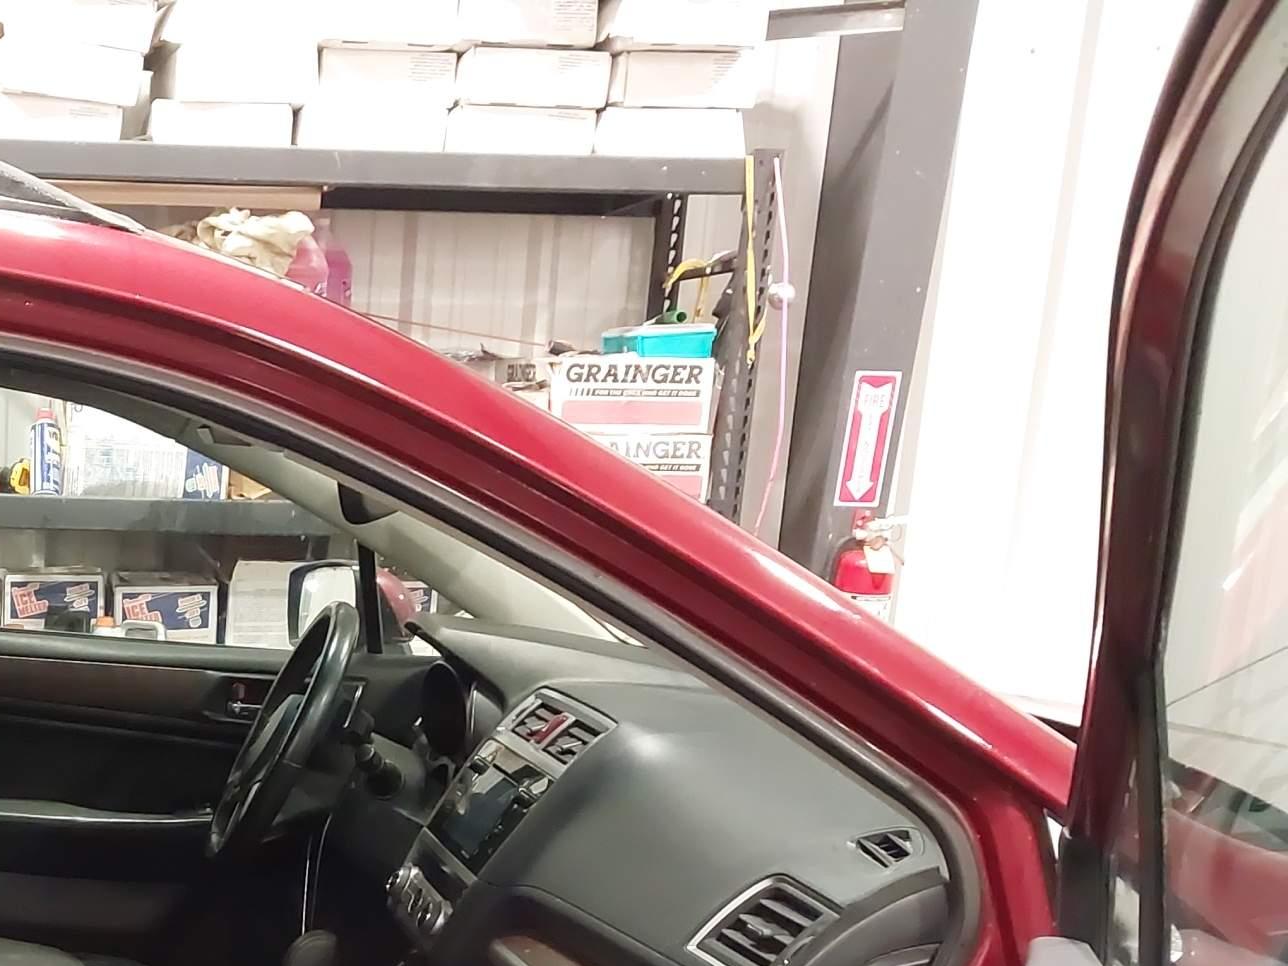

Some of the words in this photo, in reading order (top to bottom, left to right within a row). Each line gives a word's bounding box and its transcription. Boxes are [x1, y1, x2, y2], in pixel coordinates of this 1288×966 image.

[566, 363, 702, 384] GRAINGER
[15, 590, 36, 608] ICE
[125, 602, 148, 619] ICE
